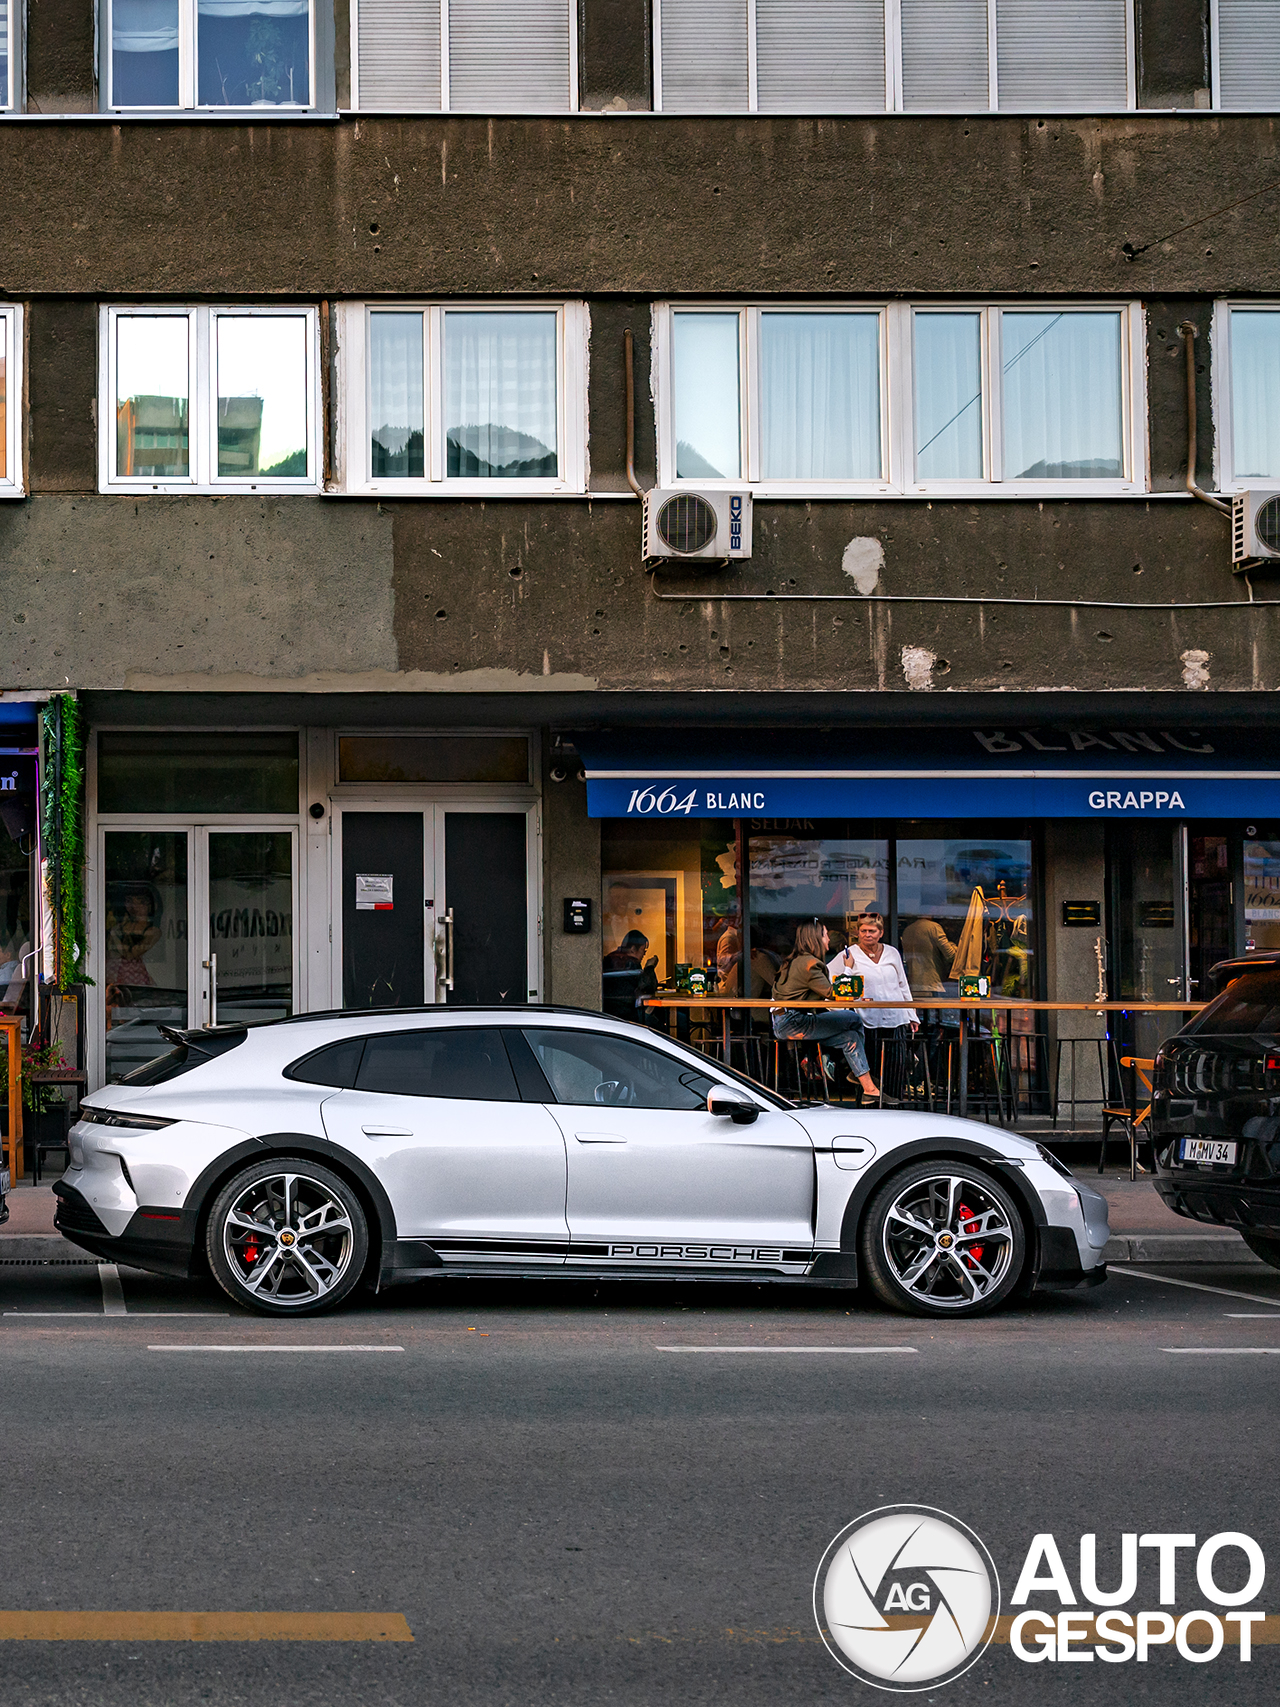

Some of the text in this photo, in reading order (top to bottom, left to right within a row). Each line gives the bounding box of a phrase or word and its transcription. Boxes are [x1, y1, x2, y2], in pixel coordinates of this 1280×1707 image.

[730, 496, 742, 550] BEKO
[627, 785, 766, 814] 1664 BLANC
[1088, 790, 1185, 809] GRAPPA
[1190, 1142, 1228, 1161] M MV 34
[611, 1244, 782, 1262] PORSCHE
